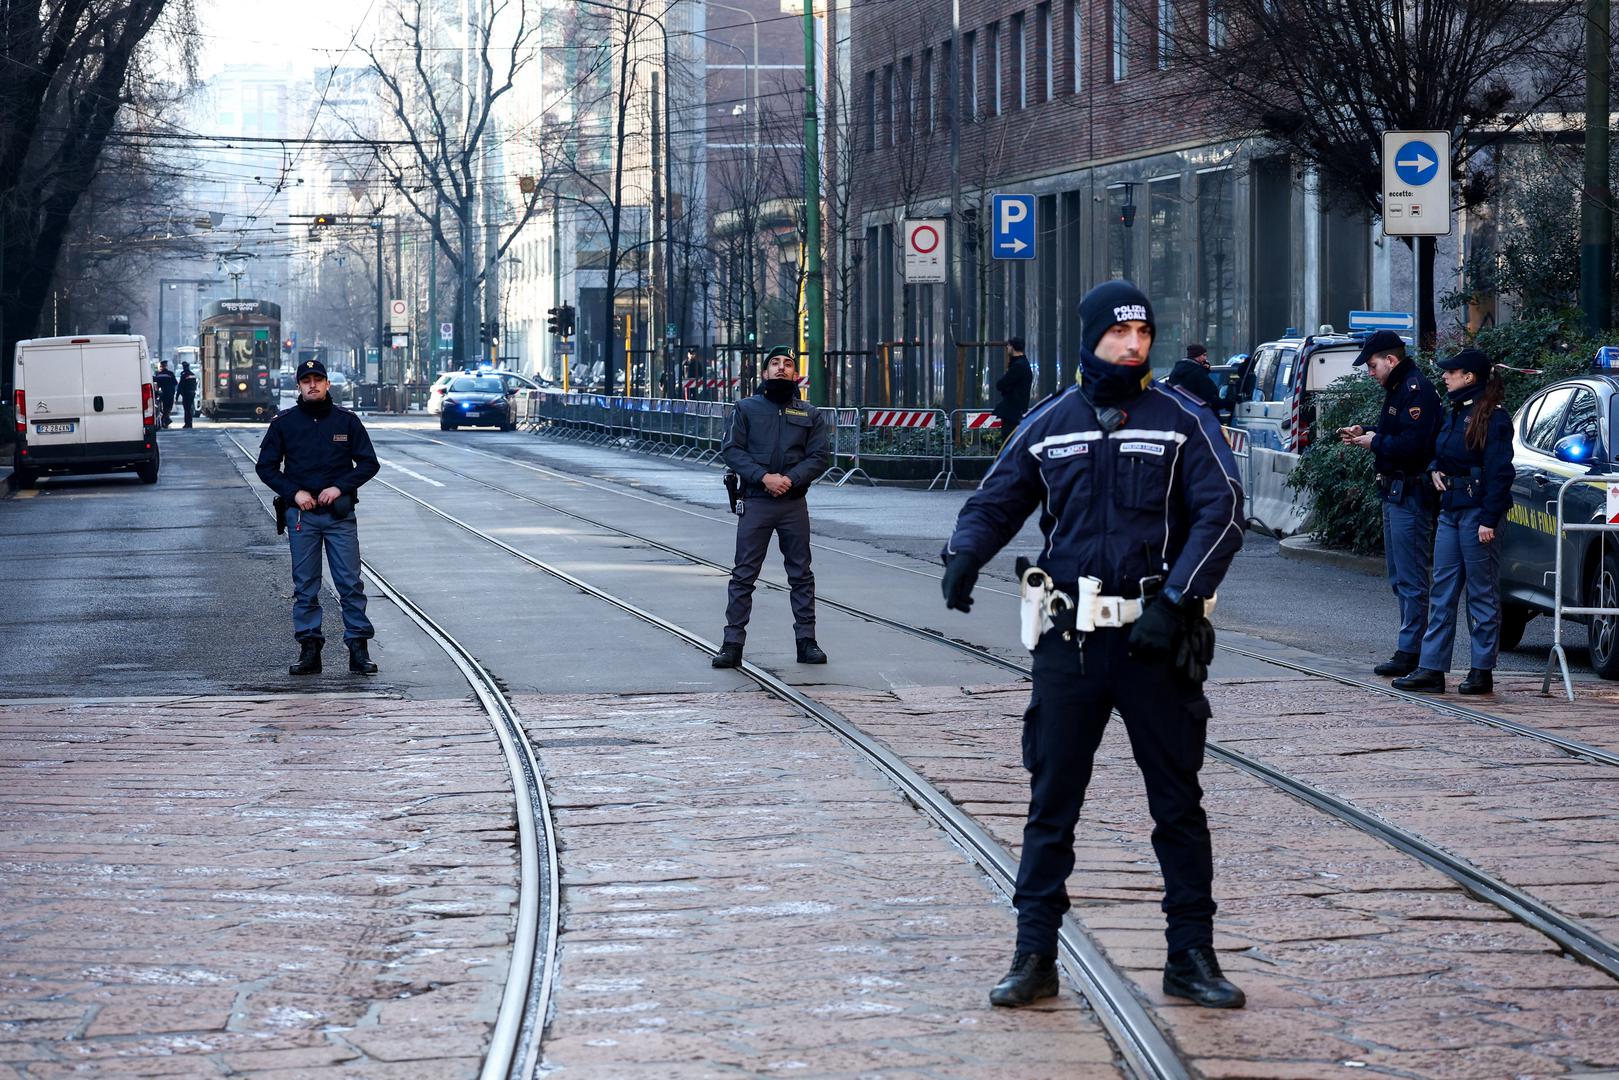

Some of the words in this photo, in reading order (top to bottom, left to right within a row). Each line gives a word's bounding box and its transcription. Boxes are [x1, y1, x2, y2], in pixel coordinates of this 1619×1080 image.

[1001, 199, 1028, 234] P
[1113, 305, 1146, 316] POLIZIA
[1117, 312, 1147, 321] LOCALE
